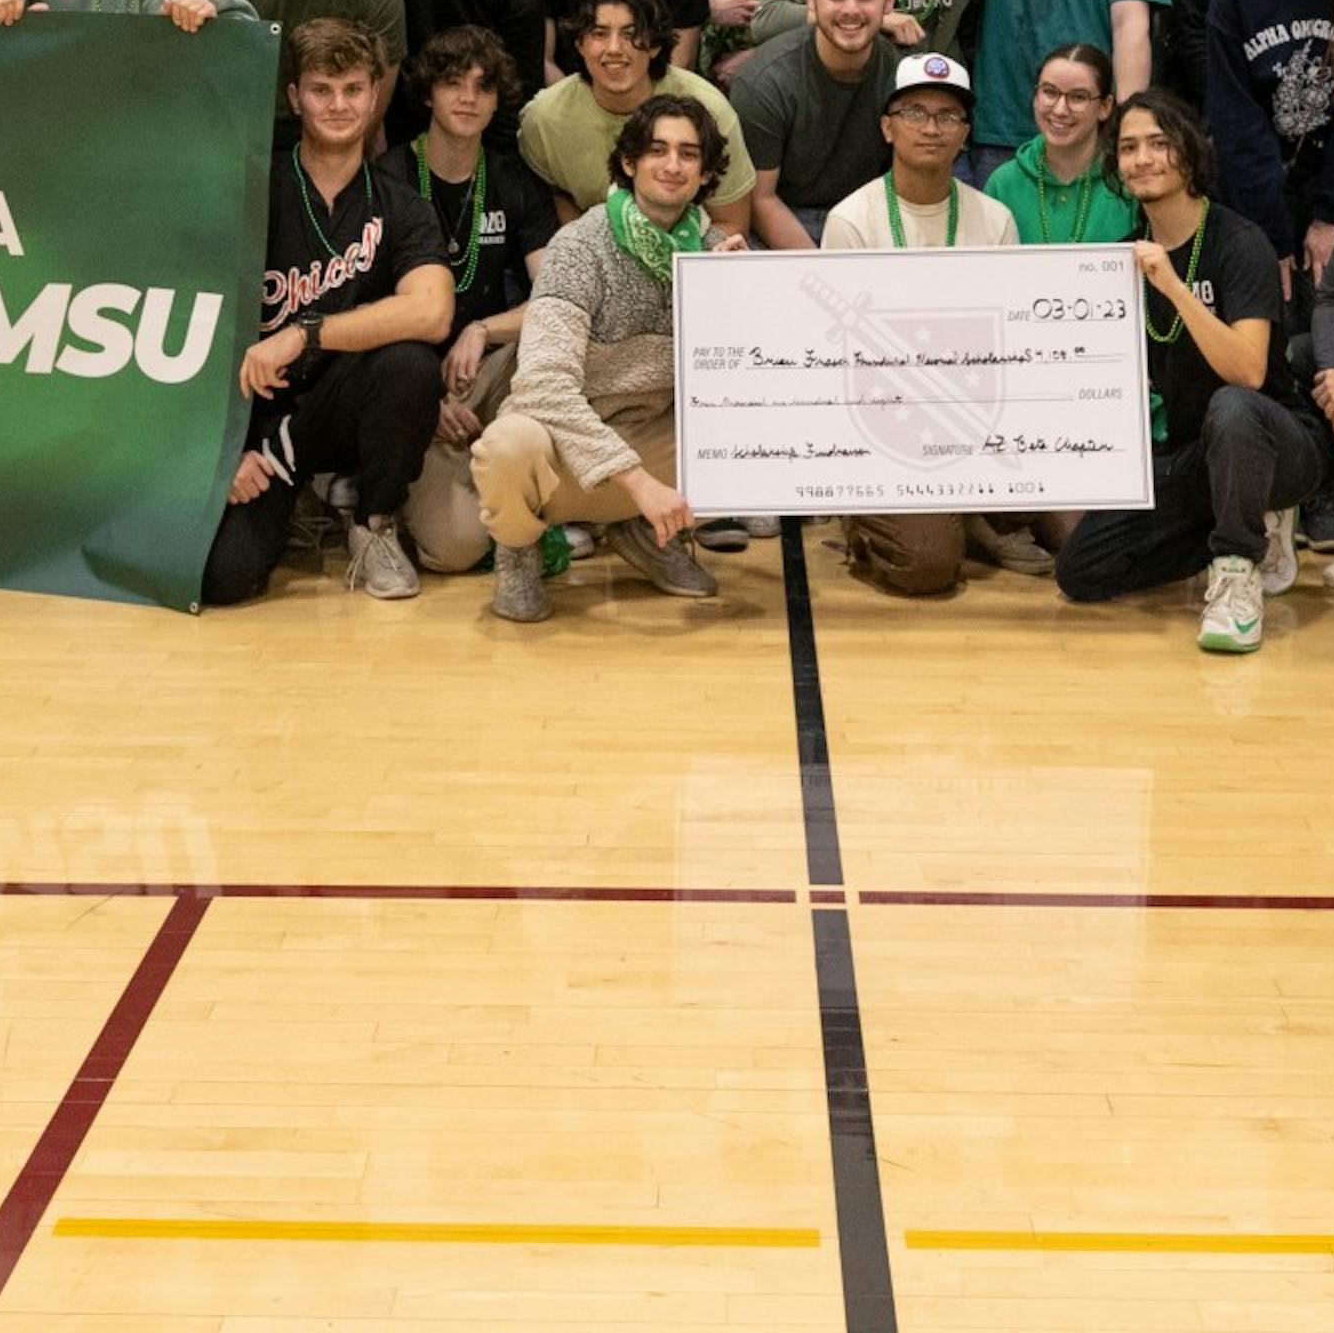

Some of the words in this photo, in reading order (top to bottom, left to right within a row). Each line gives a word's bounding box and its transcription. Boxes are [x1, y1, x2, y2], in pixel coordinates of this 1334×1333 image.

[1242, 24, 1290, 62] ALPHA
[1102, 261, 1124, 272] 001
[1007, 310, 1030, 322] DATE
[693, 346, 711, 358] PAY
[727, 346, 745, 357] THE
[693, 358, 726, 369] ORDER
[728, 358, 742, 368] OF
[1078, 389, 1123, 400] DOLLARS
[697, 448, 728, 460] MEMO
[922, 444, 974, 455] SIGNATURE
